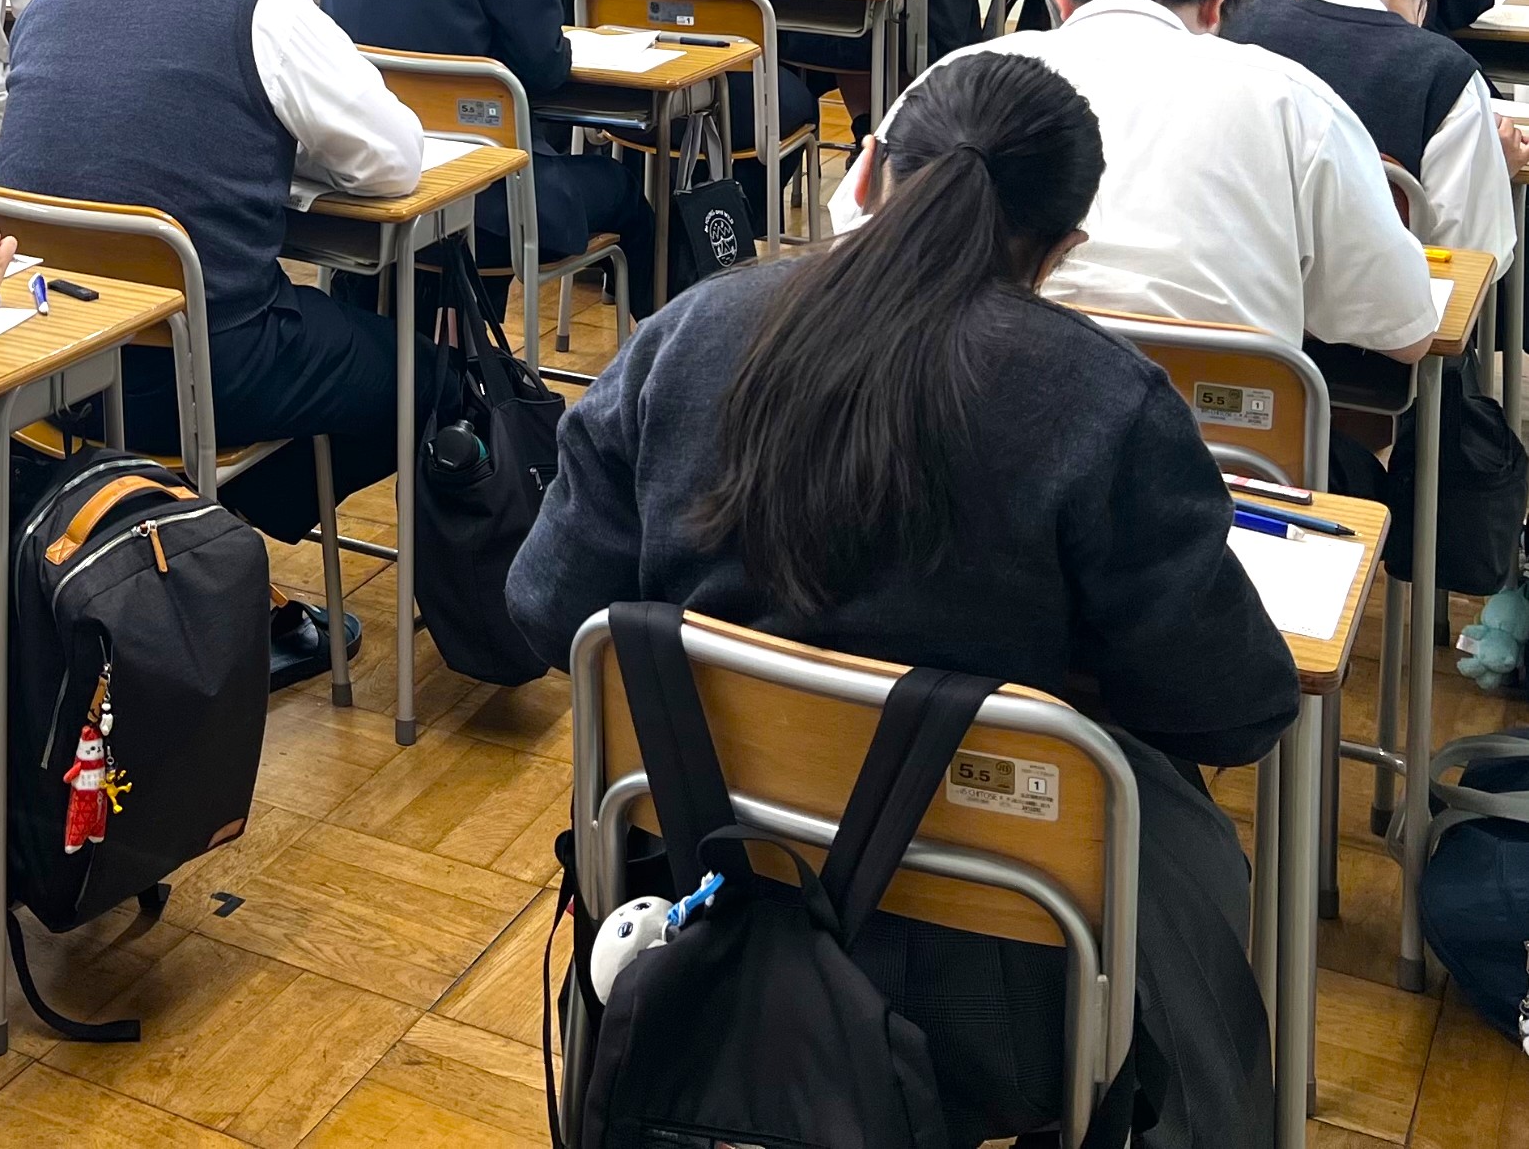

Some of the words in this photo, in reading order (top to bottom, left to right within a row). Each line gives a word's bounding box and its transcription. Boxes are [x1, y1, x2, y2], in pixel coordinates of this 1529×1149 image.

[1202, 392, 1225, 405] 5.5
[958, 763, 991, 782] 5.5
[1033, 781, 1040, 790] 1
